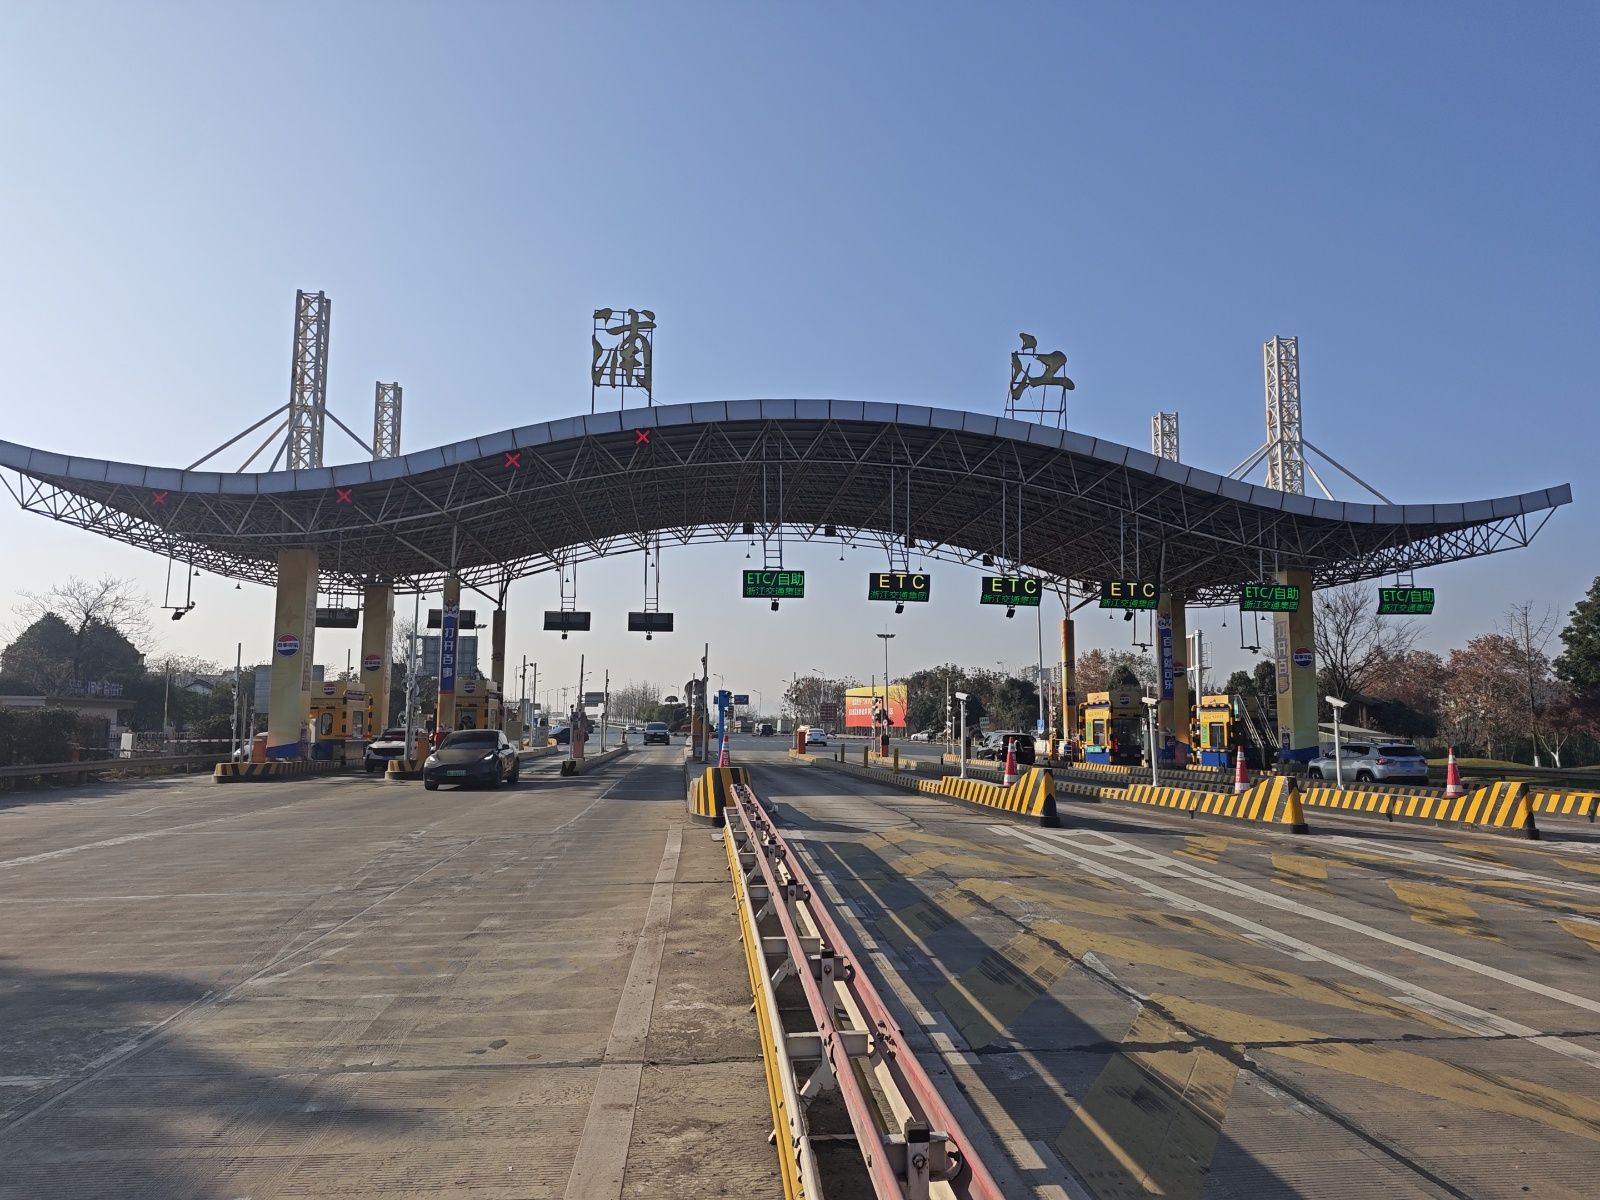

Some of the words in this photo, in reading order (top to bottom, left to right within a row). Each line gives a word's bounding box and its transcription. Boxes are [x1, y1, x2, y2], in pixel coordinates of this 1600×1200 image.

[591, 308, 657, 392] 浦
[1010, 333, 1075, 400] 江
[747, 572, 804, 586] ETC/自助
[879, 574, 925, 589] ETC
[992, 578, 1037, 594] ETC
[1111, 582, 1155, 597] ETC
[1246, 586, 1299, 600] ETC/自助
[1383, 590, 1434, 602] ETC/自助
